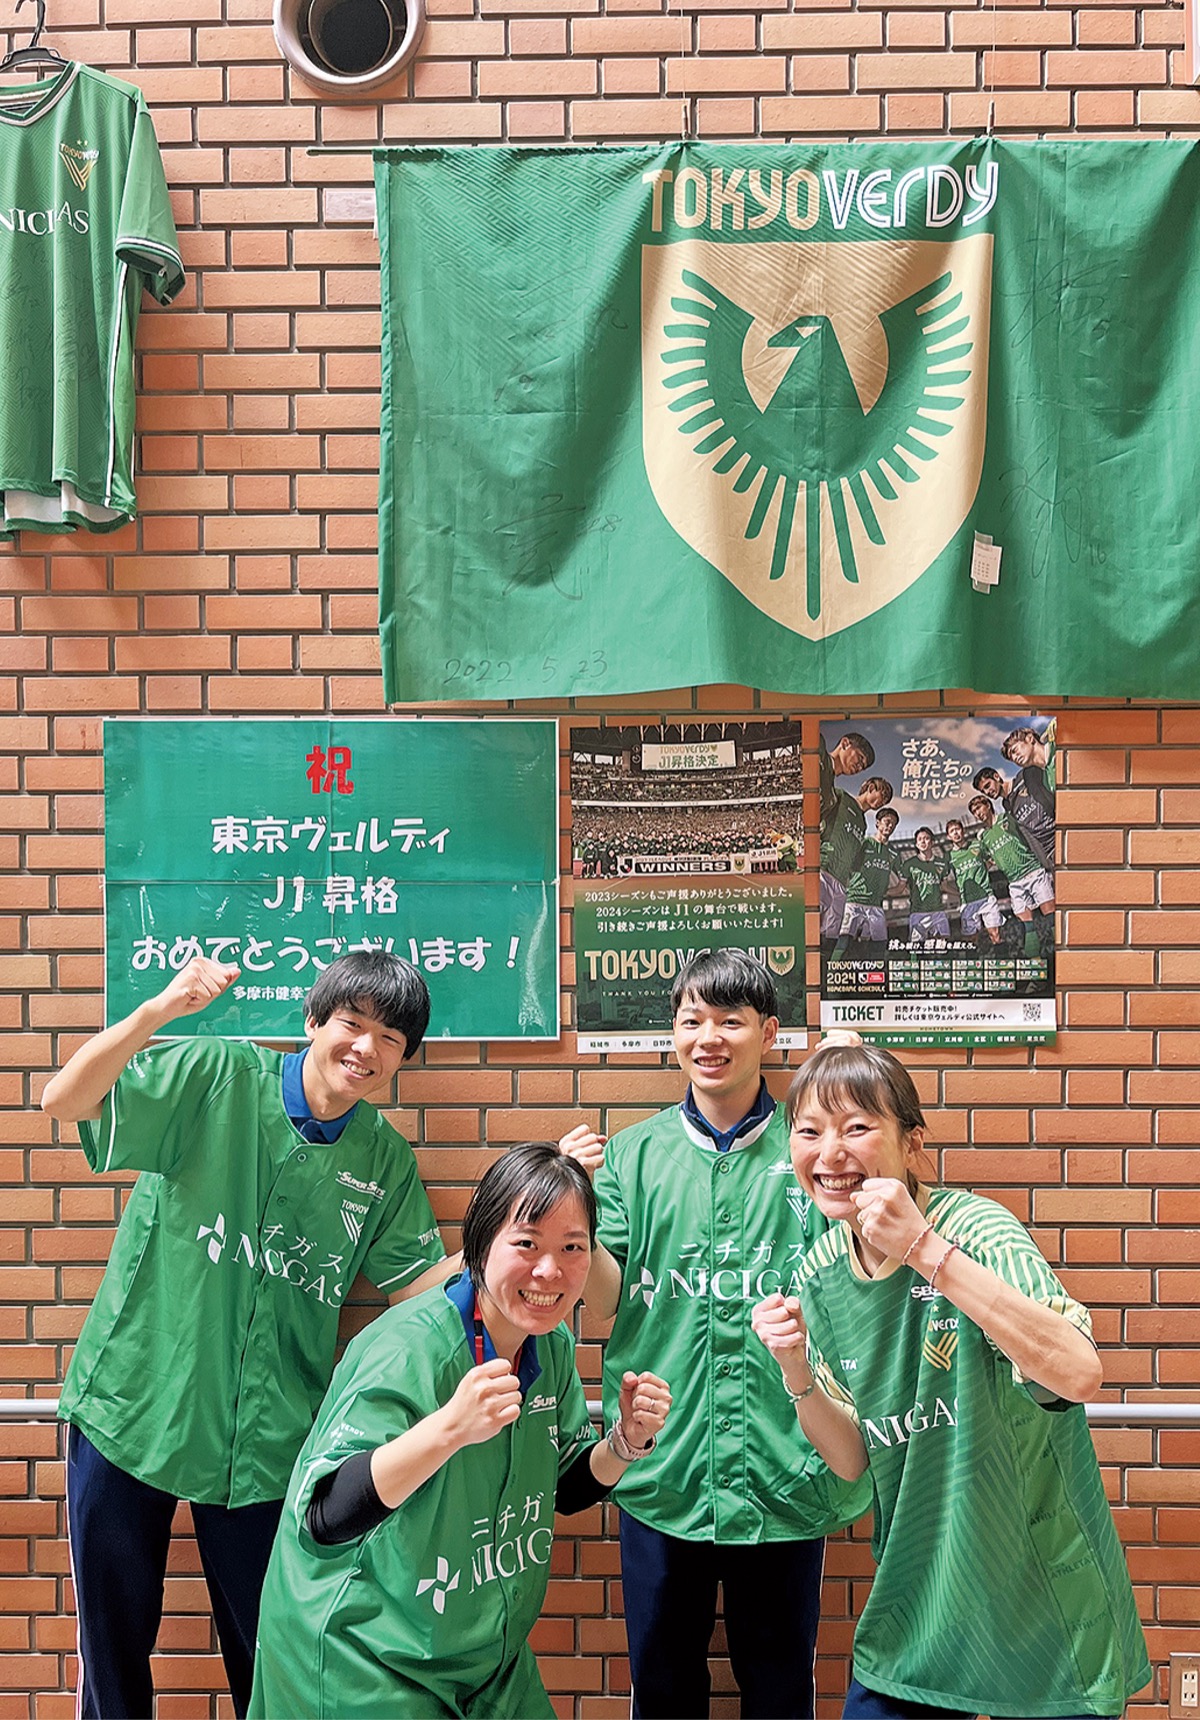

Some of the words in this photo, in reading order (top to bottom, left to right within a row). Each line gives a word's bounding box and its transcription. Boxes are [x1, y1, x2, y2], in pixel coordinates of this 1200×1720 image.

[902, 737, 946, 758] さあ、
[305, 745, 354, 794] 祝
[658, 753, 719, 768] J1昇格決定
[902, 758, 973, 779] 俺たちの
[901, 778, 967, 800] 時代だ。
[210, 815, 452, 854] 東京ヴェルディ
[639, 862, 727, 873] WINNERS
[584, 886, 793, 902] 2023シーズンもご声援ありがとうございました。
[826, 971, 856, 985] 2024
[232, 985, 312, 1001] 多摩市健幸
[832, 1005, 885, 1022] TICKET
[667, 1268, 802, 1301] NICIGA
[469, 1527, 553, 1594] NICIG
